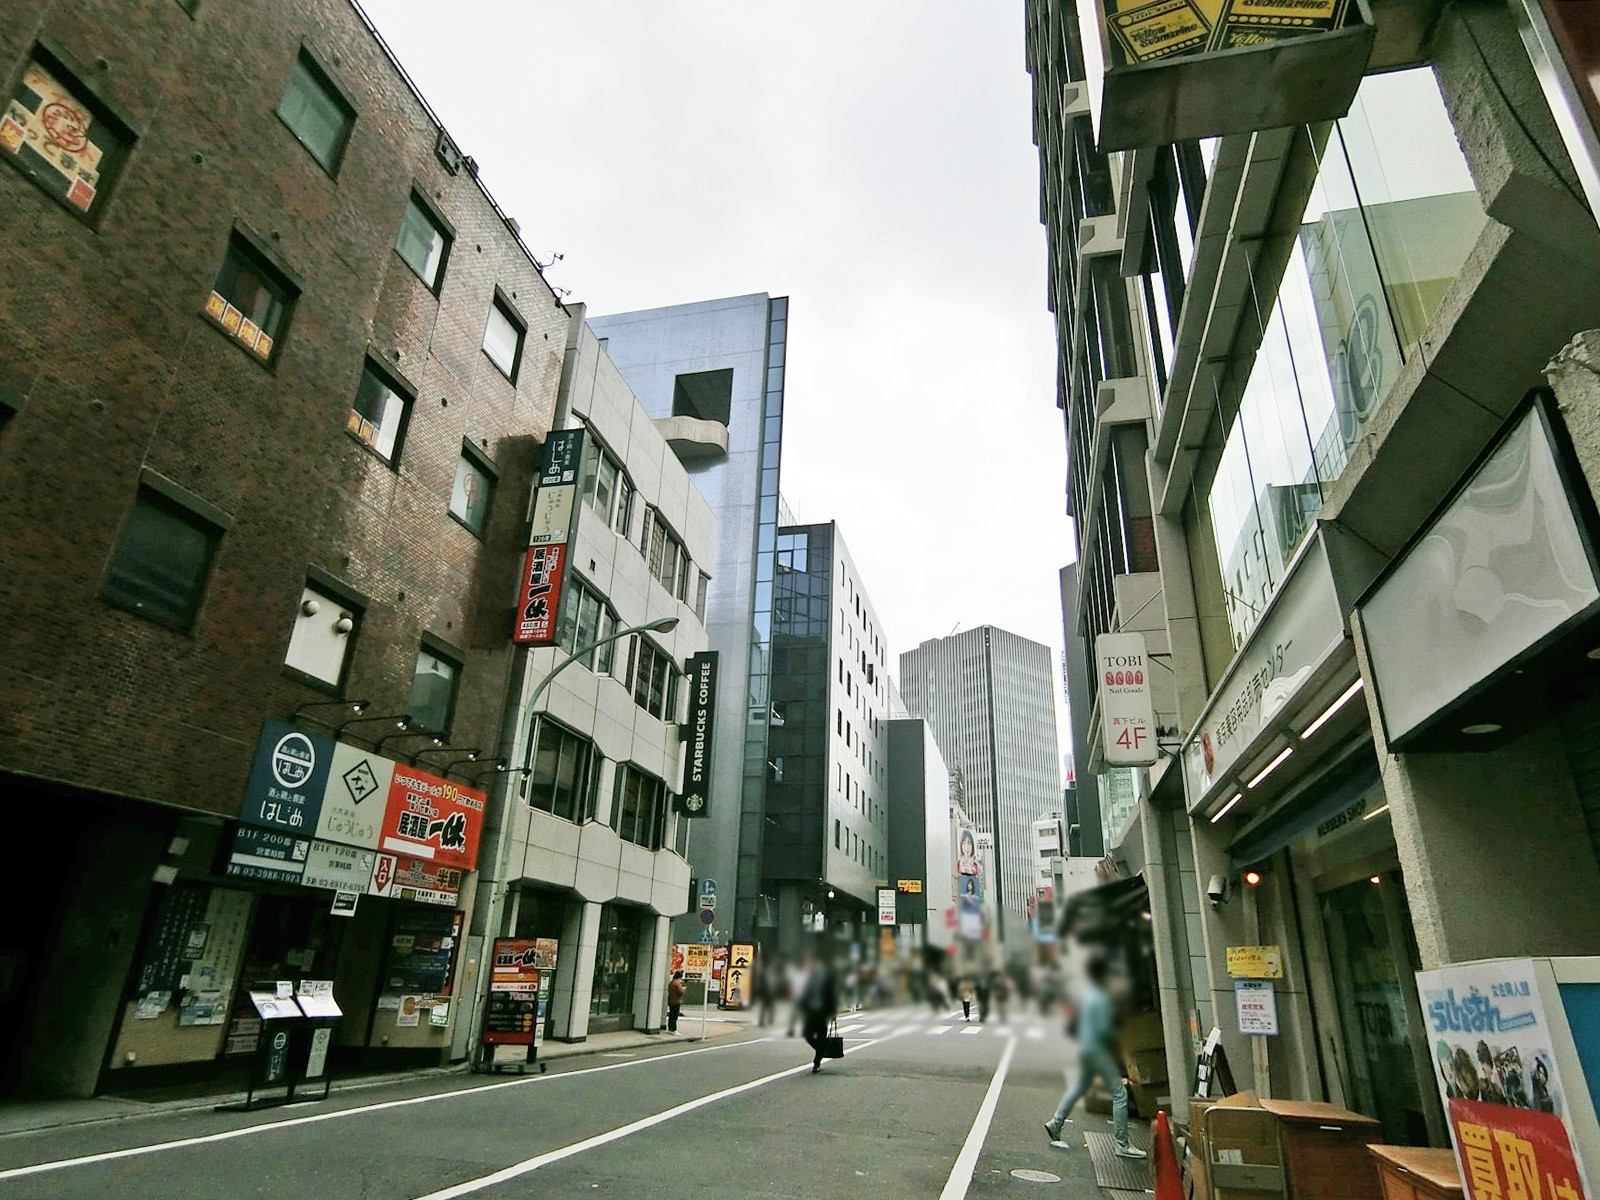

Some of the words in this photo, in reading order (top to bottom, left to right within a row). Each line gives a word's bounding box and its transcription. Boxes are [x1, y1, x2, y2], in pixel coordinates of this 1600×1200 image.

[1103, 655, 1142, 667] TOBI
[699, 662, 711, 706] COFFEE
[692, 709, 707, 782] STARBUCKS
[1115, 727, 1147, 749] 4F
[260, 800, 304, 828] はじめ
[378, 860, 388, 883] 入口
